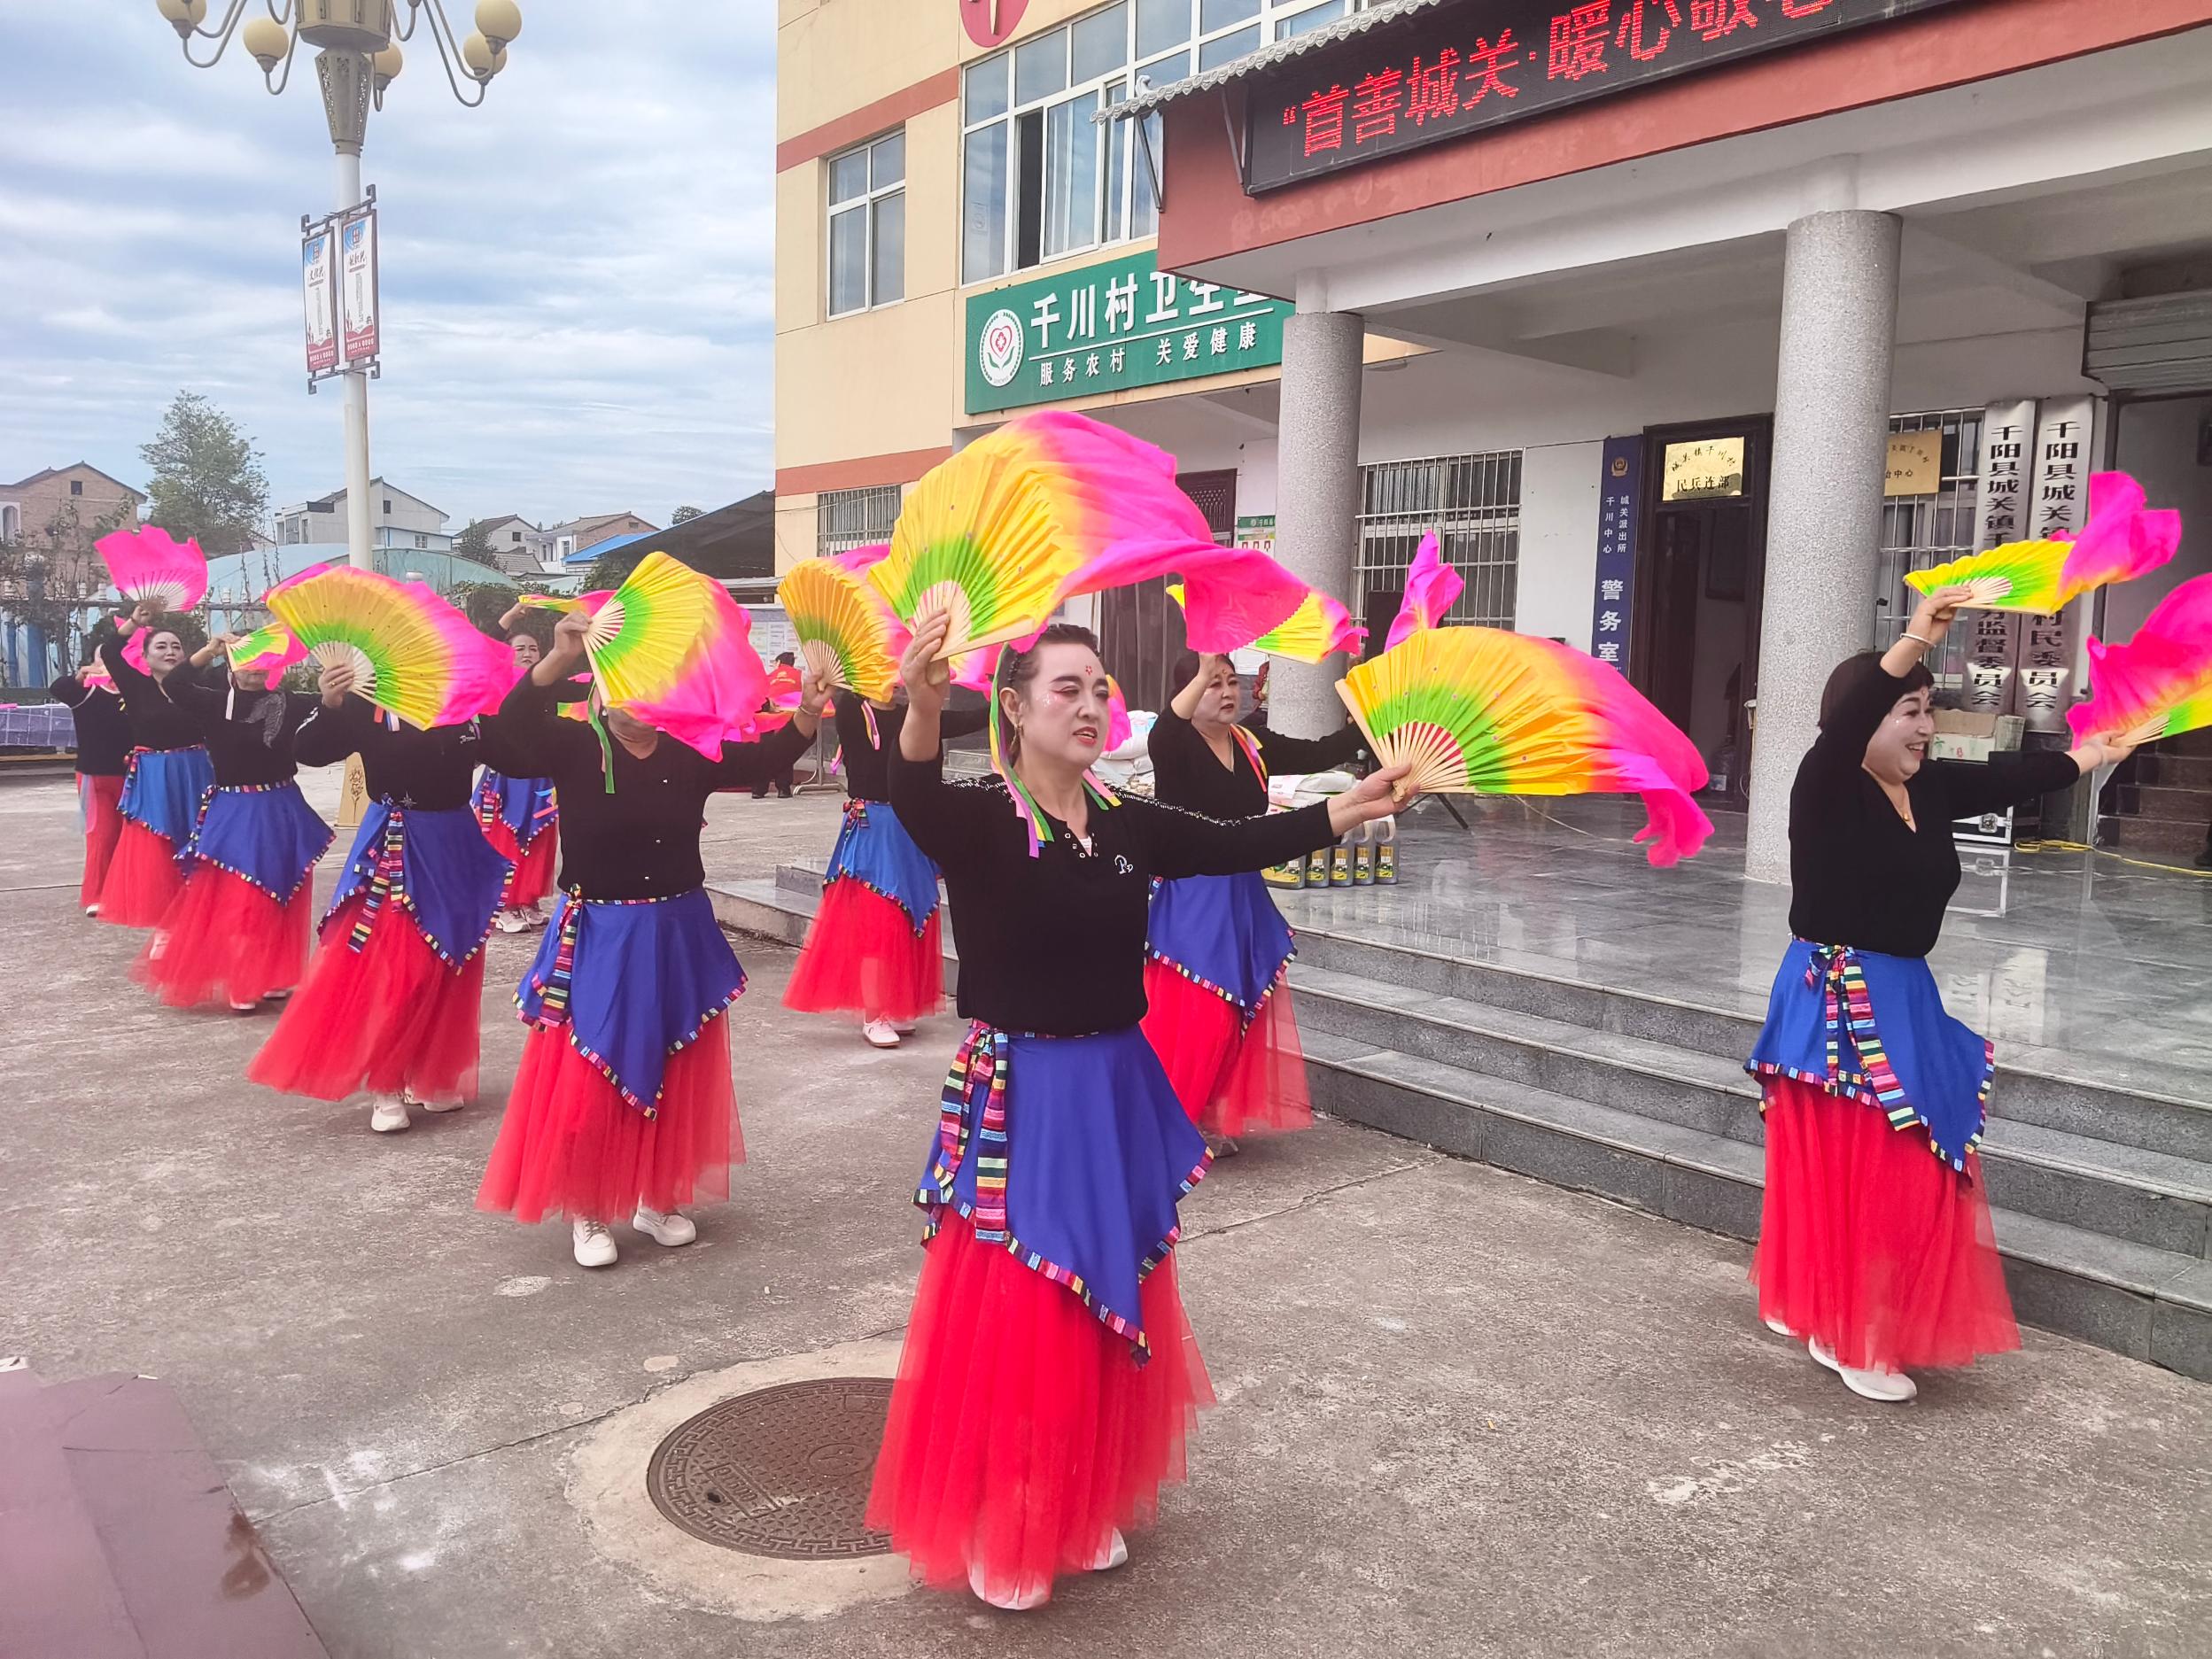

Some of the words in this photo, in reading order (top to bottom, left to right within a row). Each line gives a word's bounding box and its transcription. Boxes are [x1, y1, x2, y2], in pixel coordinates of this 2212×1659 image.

[1282, 0, 1833, 158] “首善城关·暖心敬
[1030, 271, 1272, 349] 千川村卫生
[1039, 348, 1125, 388] 服务农村
[1155, 322, 1258, 366] 关爱健康
[1603, 496, 1615, 554] 千川中心
[1617, 494, 1630, 554] 城关派出所
[1598, 579, 1624, 662] 警务室
